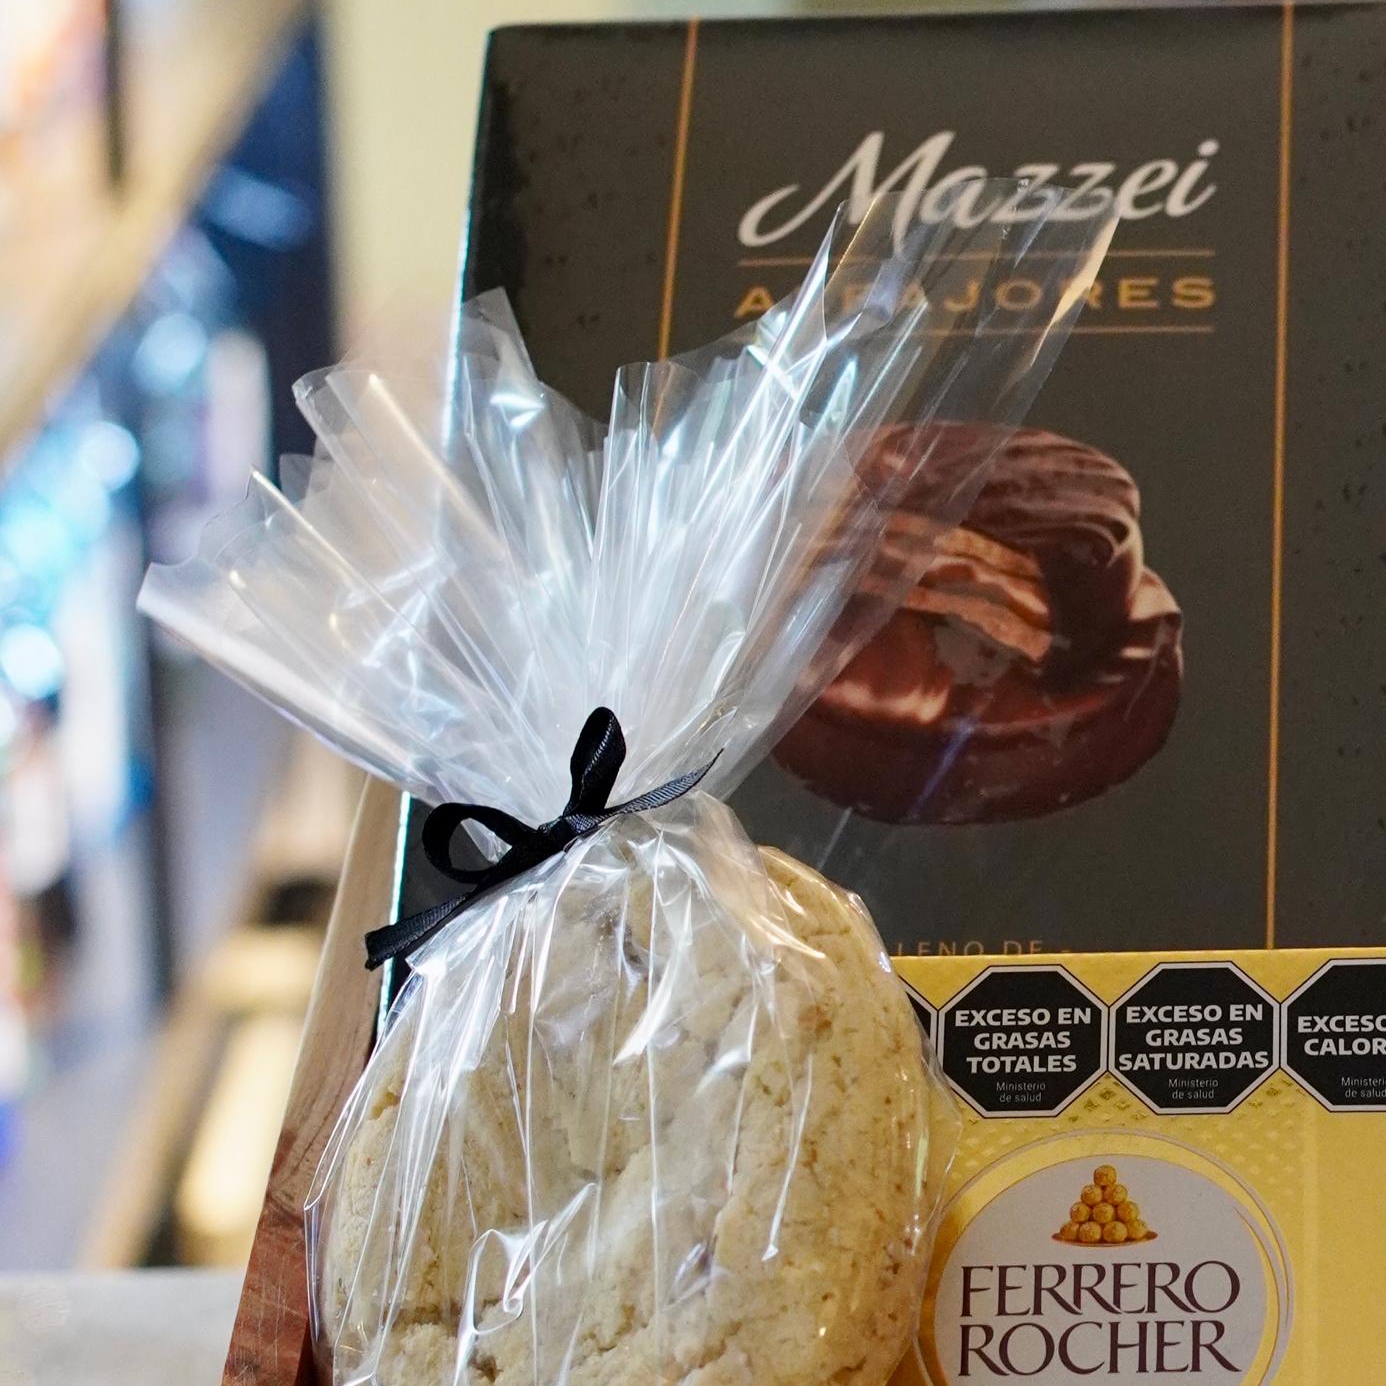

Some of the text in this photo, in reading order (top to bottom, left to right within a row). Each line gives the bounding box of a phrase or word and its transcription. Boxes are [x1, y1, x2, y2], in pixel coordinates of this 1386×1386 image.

[738, 130, 1220, 247] Mazzei
[954, 1007, 1091, 1027] EXCESO EN
[1126, 1003, 1263, 1023] EXCESO EN
[973, 1031, 1072, 1050] GRASAS
[1145, 1027, 1243, 1046] GRASAS
[966, 1054, 1077, 1074] TOTALES
[1118, 1051, 1269, 1071] SATURADAS
[996, 1081, 1046, 1091] Ministerio
[1168, 1077, 1219, 1088] Ministerio
[999, 1092, 1042, 1102] de salud
[1172, 1088, 1214, 1100] de salud
[1345, 1087, 1358, 1098] de
[960, 1260, 1241, 1318] FERRERO
[958, 1319, 1243, 1377] ROCHER
